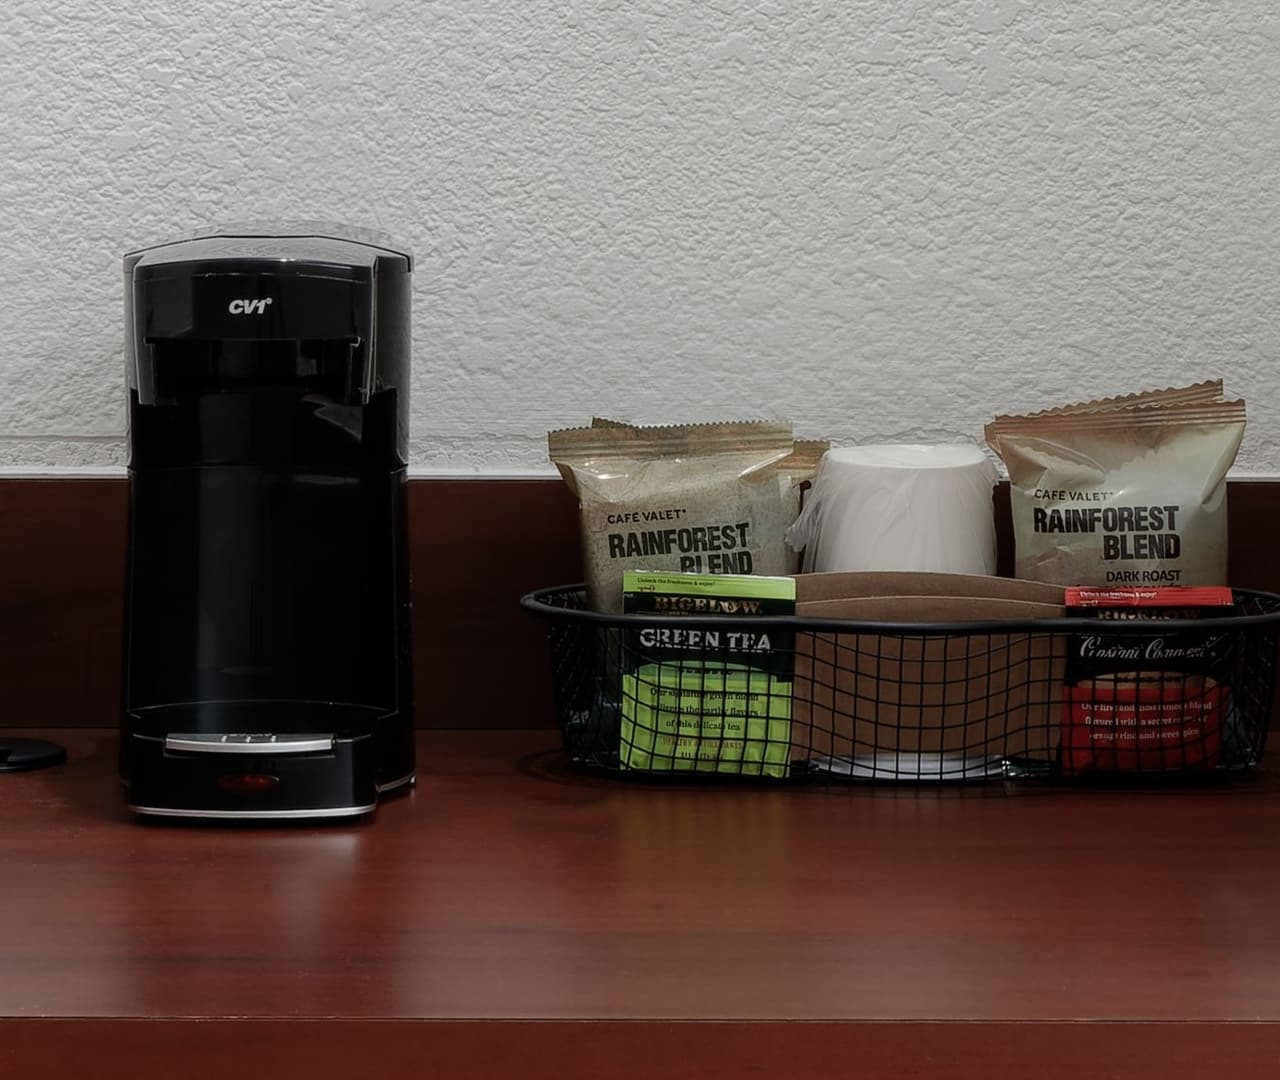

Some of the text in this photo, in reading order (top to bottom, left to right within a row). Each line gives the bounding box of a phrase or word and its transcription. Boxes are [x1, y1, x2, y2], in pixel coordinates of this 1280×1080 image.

[1069, 491, 1108, 501] VALET
[642, 509, 681, 521] VALET
[1033, 506, 1180, 533] RAINFOREST
[608, 522, 750, 558] RAINFOREST
[1103, 534, 1181, 560] BLEND
[680, 550, 753, 575] BLEND
[1106, 570, 1182, 582] DARK ROAST
[639, 629, 774, 653] GREEN TEA
